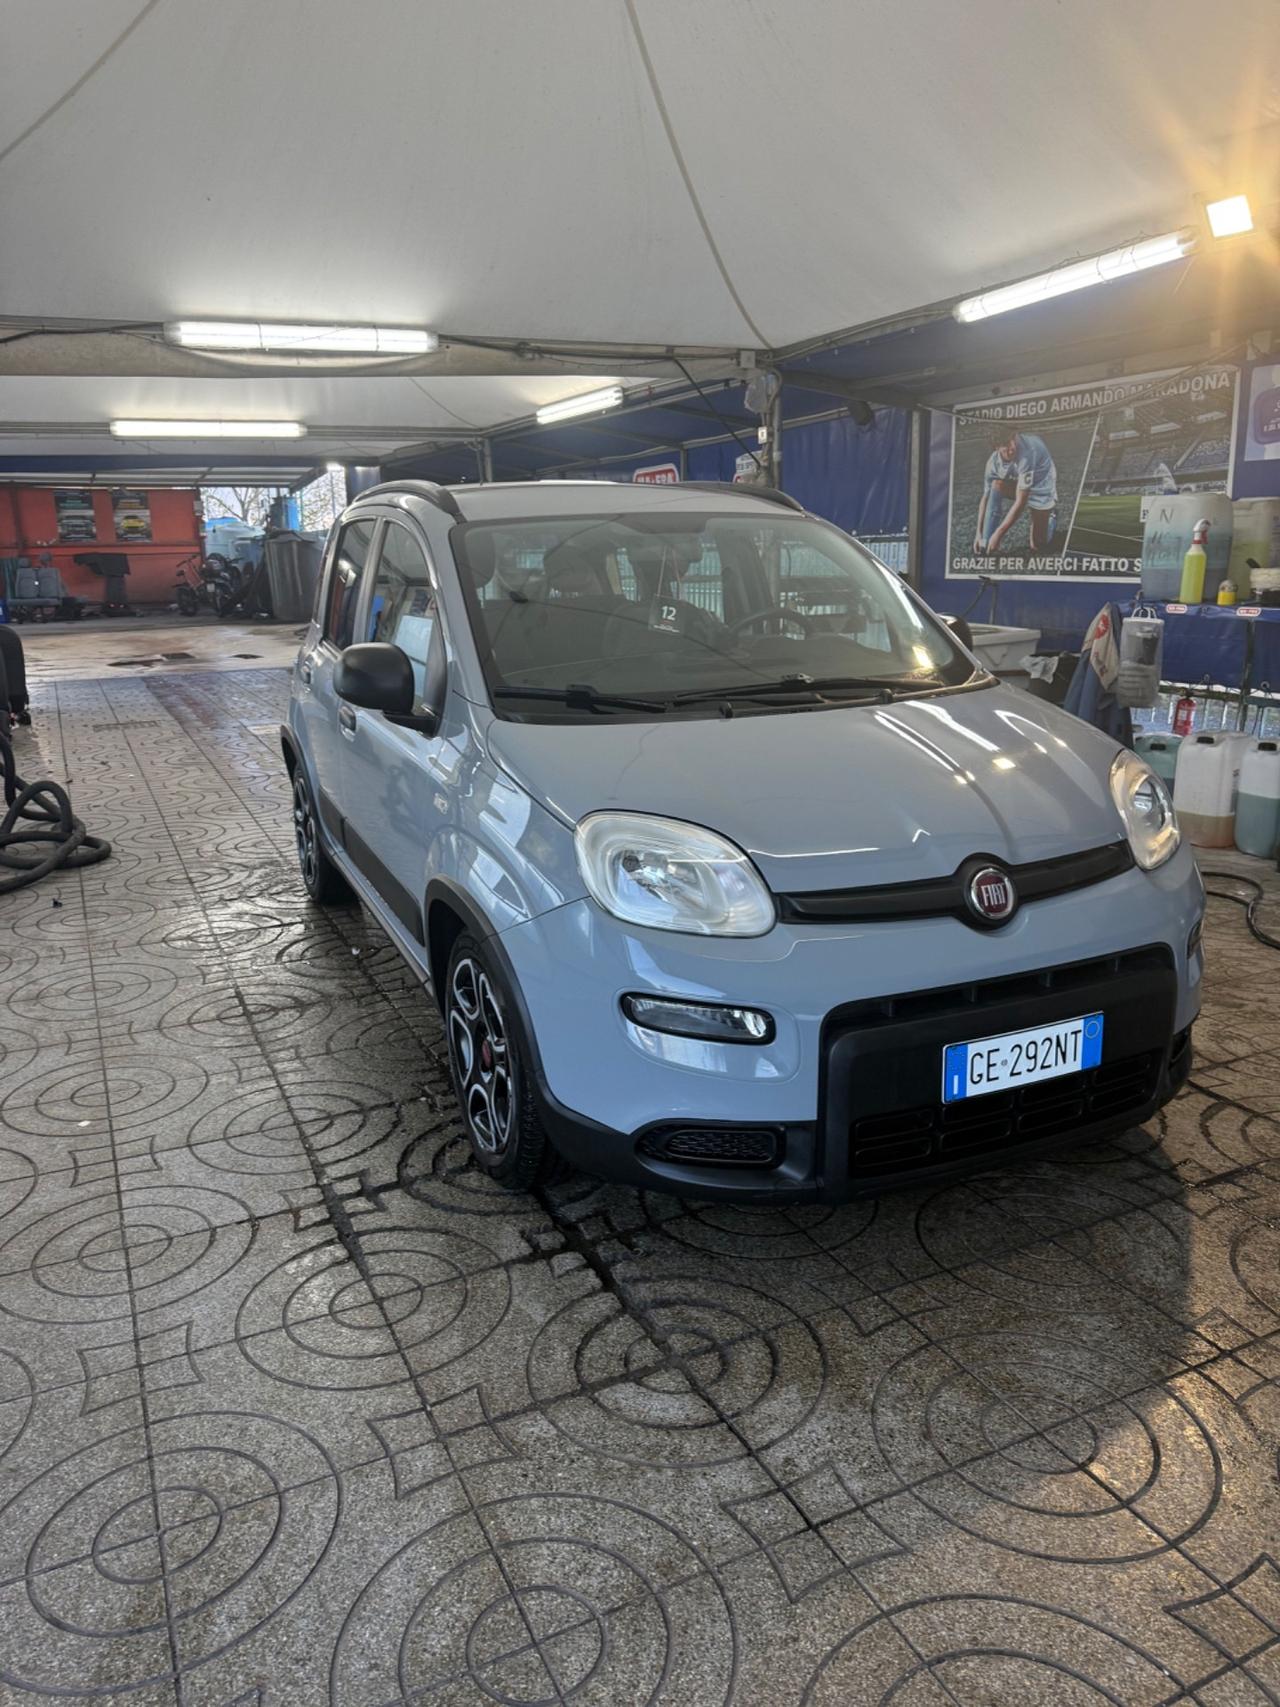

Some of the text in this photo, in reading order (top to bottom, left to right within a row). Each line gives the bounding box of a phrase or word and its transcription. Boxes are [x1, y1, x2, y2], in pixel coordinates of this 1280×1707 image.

[959, 407, 1002, 426] STADIO
[1006, 400, 1047, 419] DIEGO
[1050, 388, 1125, 413] ARMANDO
[953, 556, 996, 570] GRAZIE
[999, 557, 1024, 570] PER
[1027, 557, 1078, 571] AVERCI
[1082, 557, 1128, 572] FATTO
[661, 605, 677, 621] 12
[981, 884, 1005, 907] FIAT
